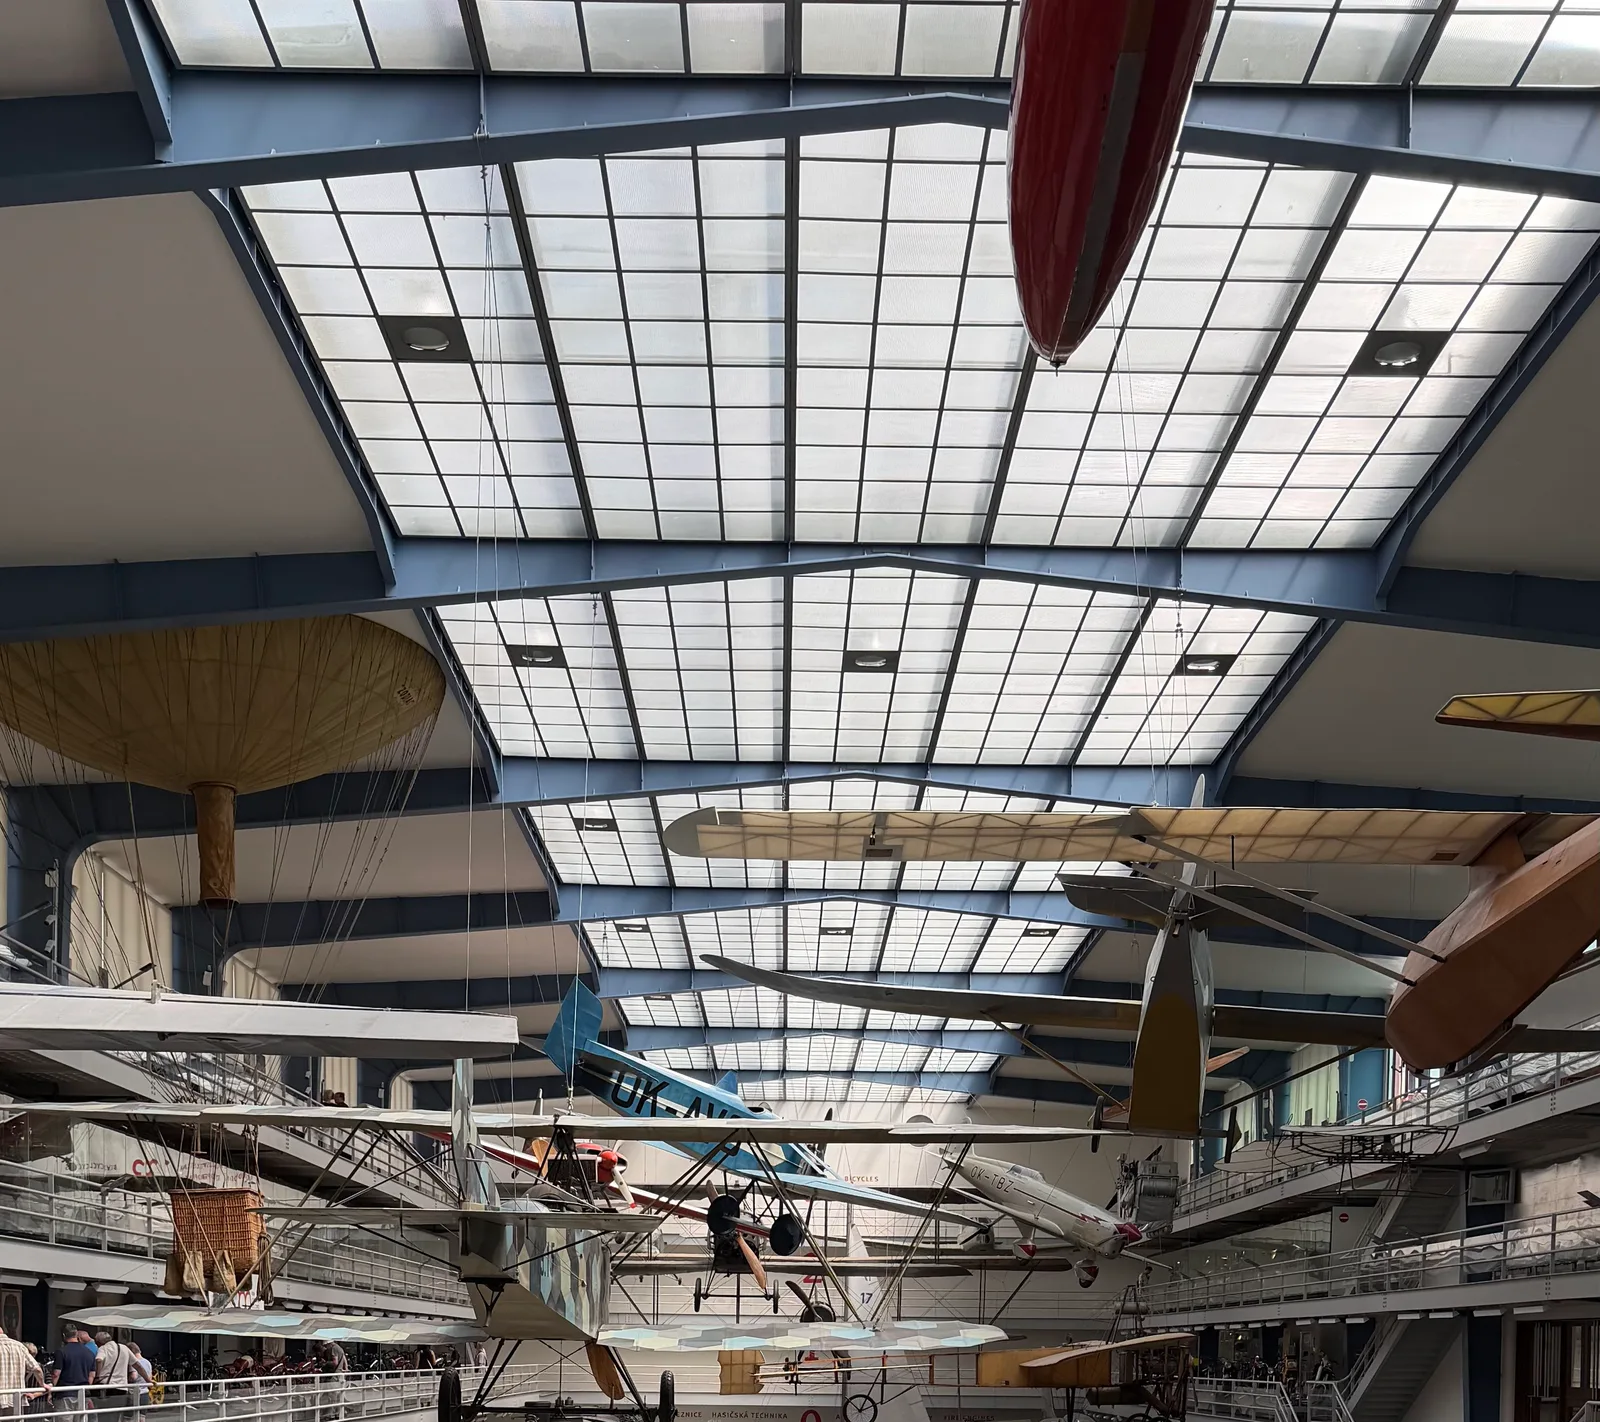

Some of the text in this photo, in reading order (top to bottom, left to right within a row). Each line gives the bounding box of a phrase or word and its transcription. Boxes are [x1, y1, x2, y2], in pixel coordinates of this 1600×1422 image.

[611, 1070, 742, 1118] OK-A
[970, 1165, 1015, 1193] OK-TBZ
[860, 1292, 873, 1304] 17
[711, 1408, 788, 1419] HASIČSKÁ TECHNIKA
